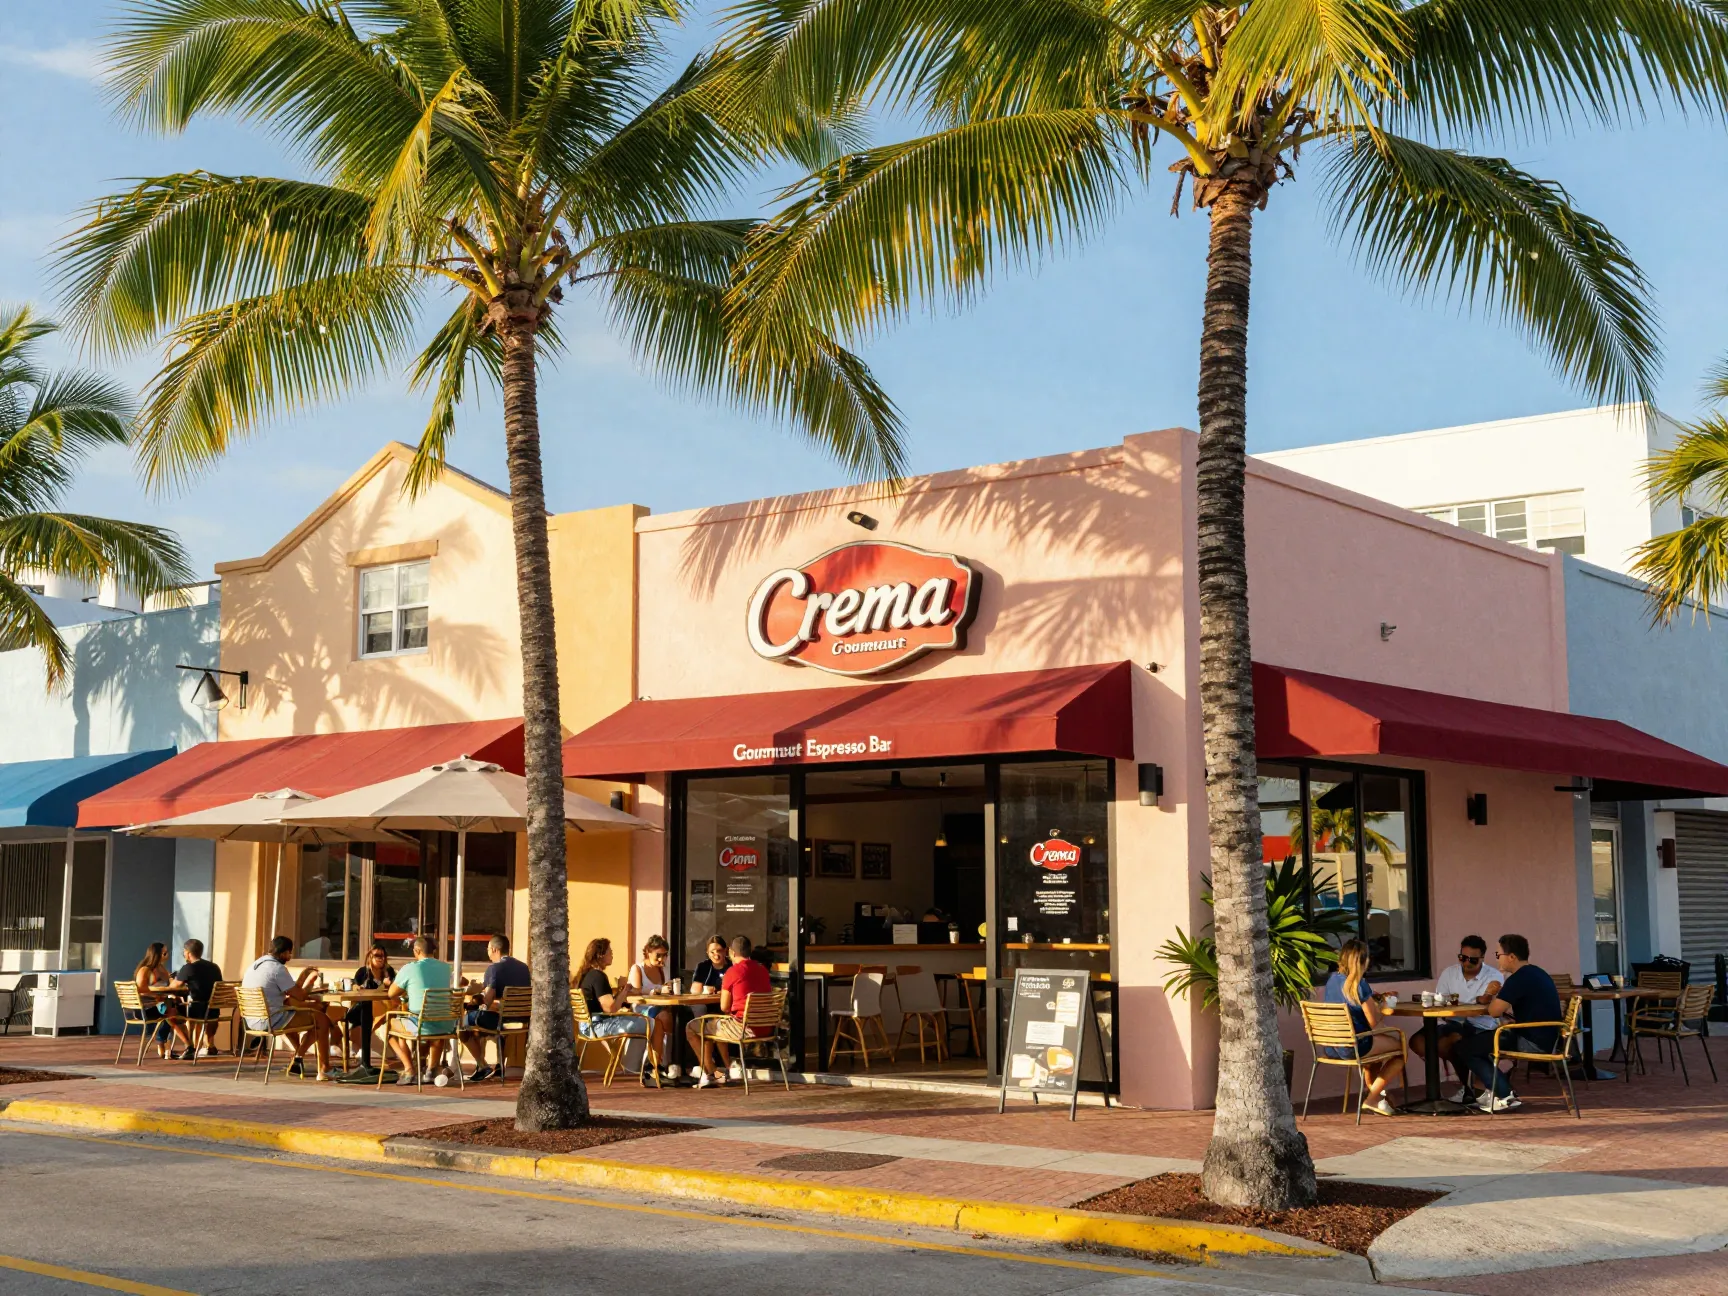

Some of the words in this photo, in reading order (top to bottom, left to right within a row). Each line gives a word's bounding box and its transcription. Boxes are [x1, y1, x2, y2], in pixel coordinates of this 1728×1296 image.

[748, 568, 955, 658] Crema
[806, 739, 866, 759] Espresso
[869, 735, 892, 752] Bar
